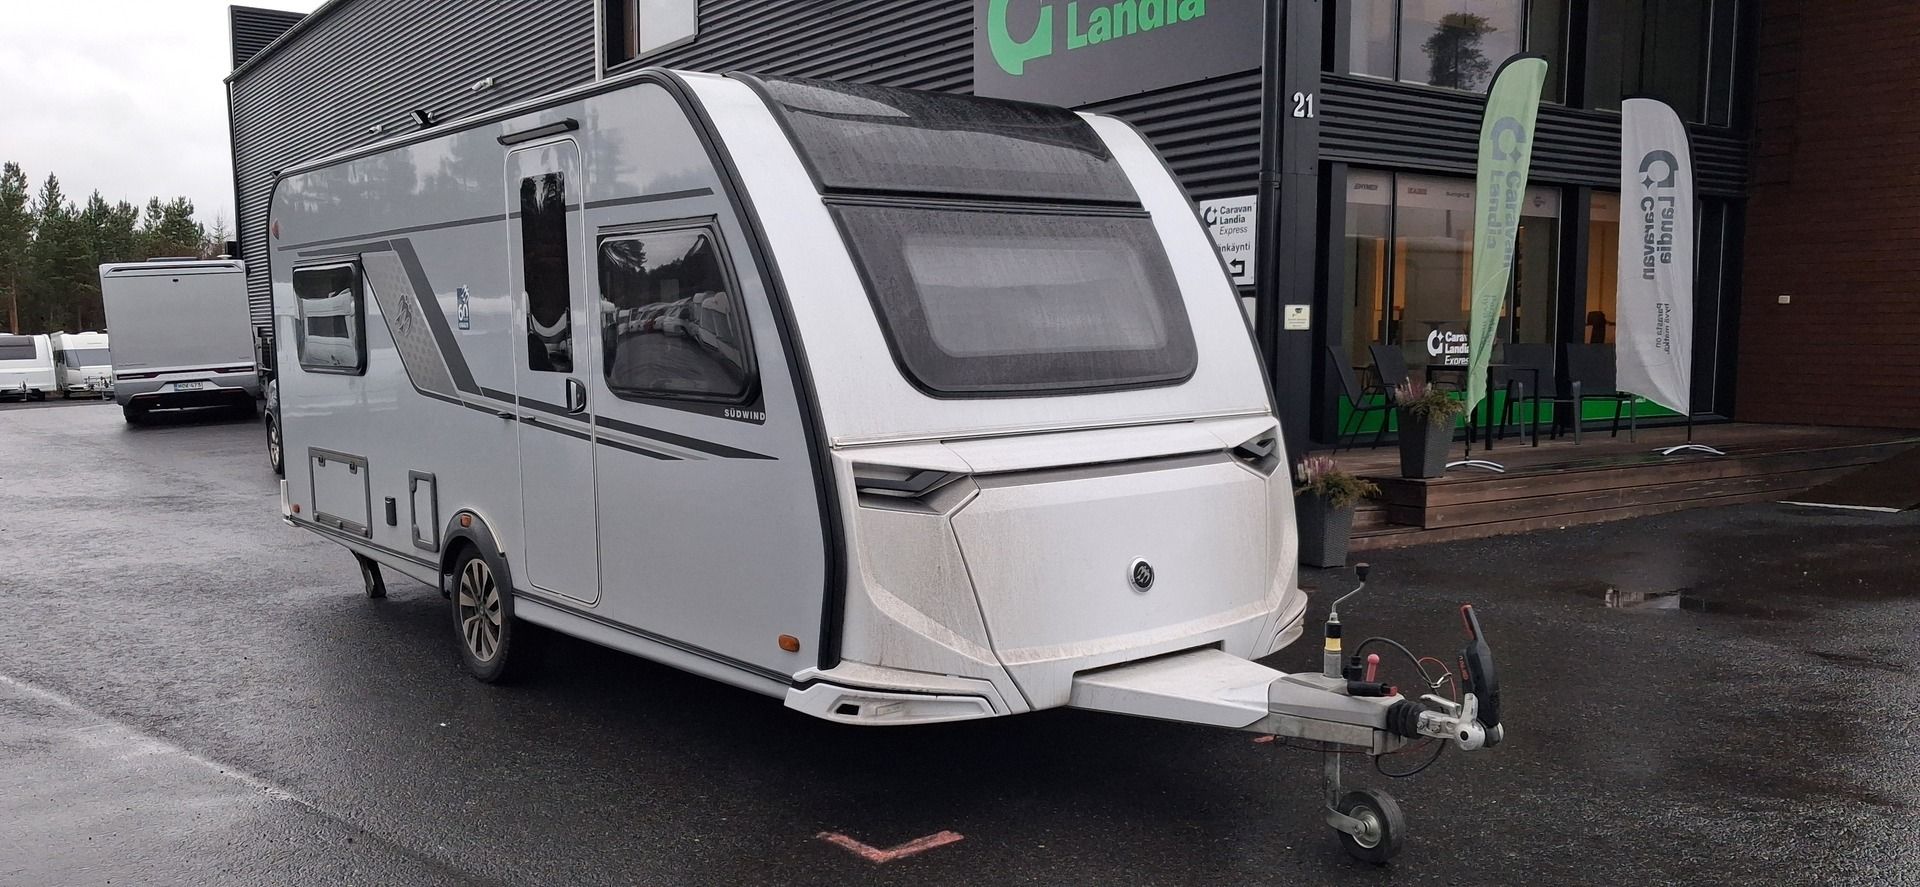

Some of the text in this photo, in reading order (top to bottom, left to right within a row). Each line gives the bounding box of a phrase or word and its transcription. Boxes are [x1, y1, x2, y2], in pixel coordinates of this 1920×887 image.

[1293, 92, 1314, 118] 21
[1220, 205, 1252, 215] Caravan
[1487, 170, 1505, 249] Landia
[1220, 214, 1246, 225] Landia
[1503, 170, 1521, 269] Caravan
[1219, 226, 1248, 236] Express
[724, 408, 766, 421] SÜDWIND
